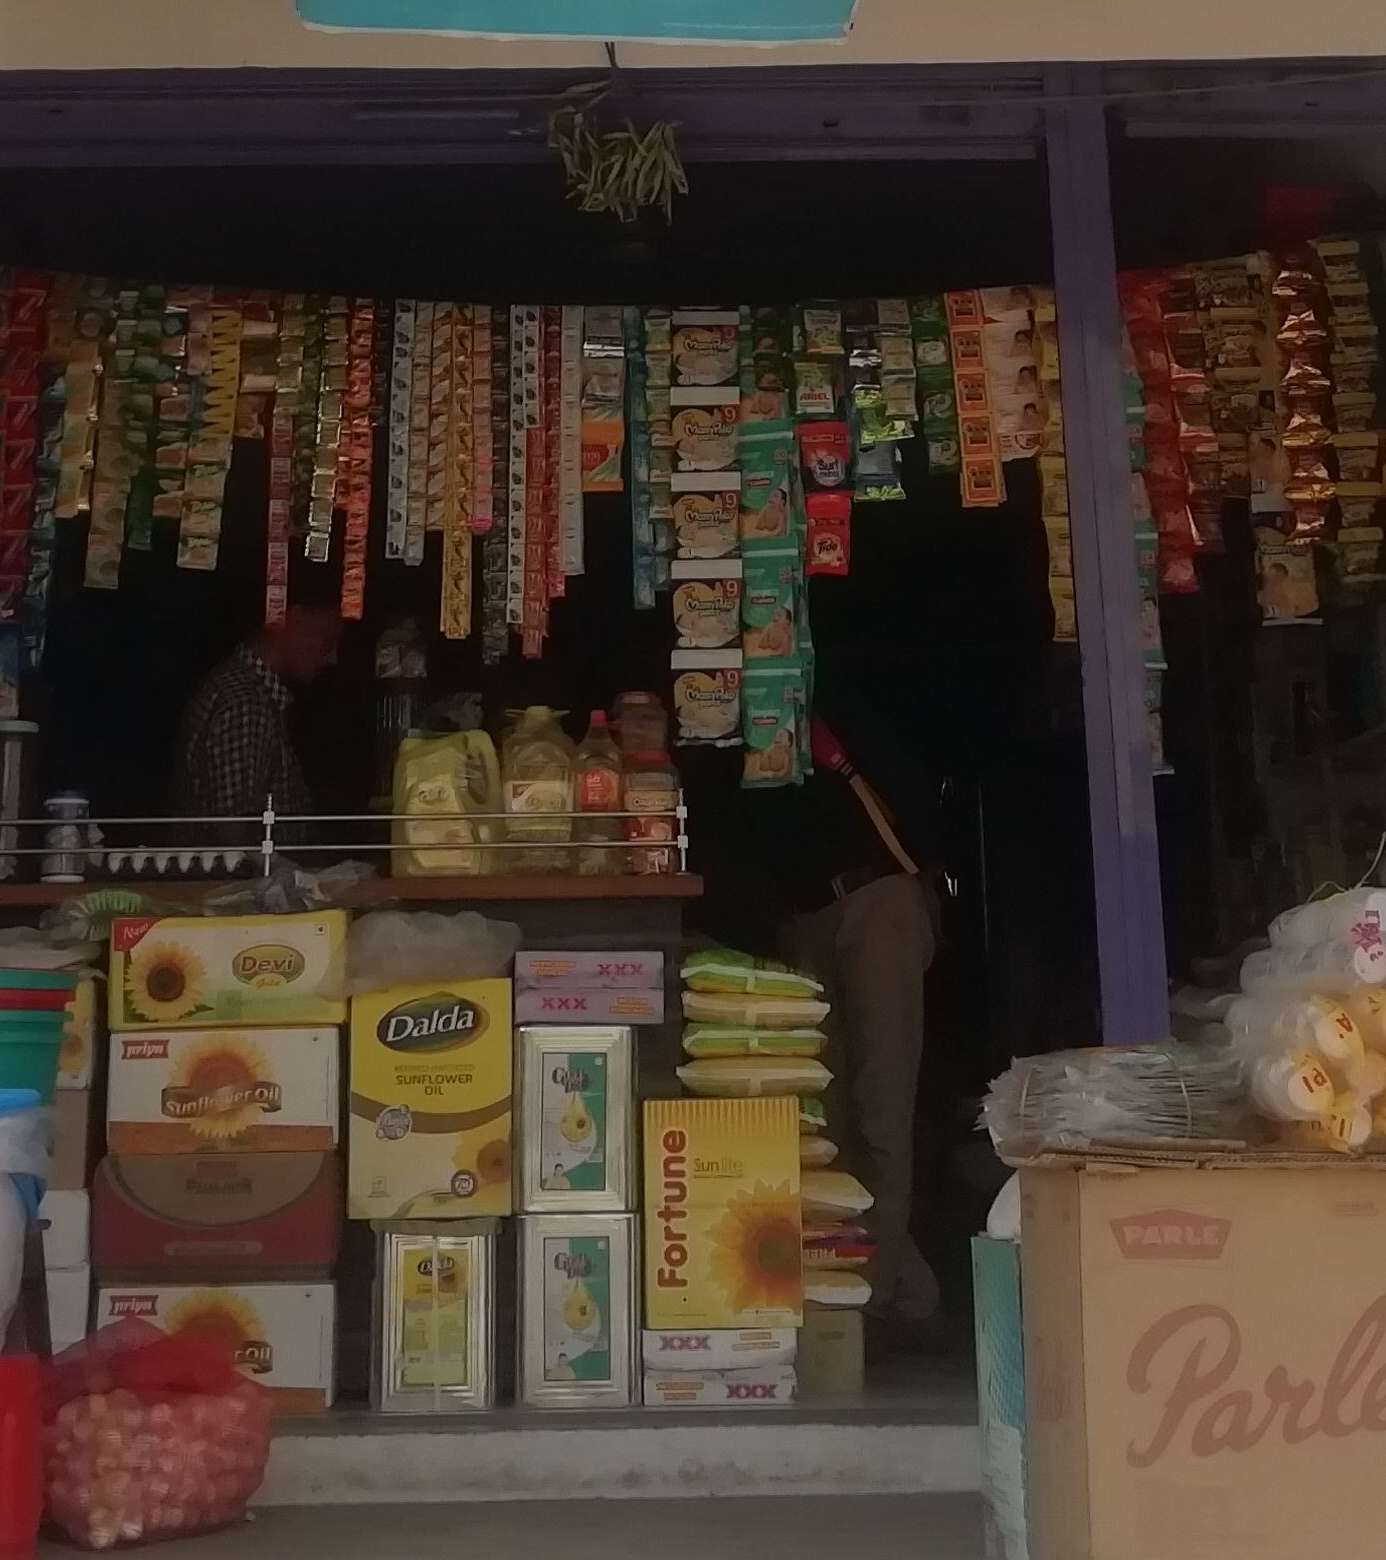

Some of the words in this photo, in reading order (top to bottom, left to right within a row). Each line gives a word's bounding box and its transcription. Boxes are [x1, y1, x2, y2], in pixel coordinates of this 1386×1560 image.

[725, 493, 736, 508] 9
[726, 580, 738, 597] 9
[727, 670, 739, 687] 9
[240, 954, 295, 973] Devi
[598, 962, 646, 978] XXX
[540, 996, 589, 1011] XXX
[386, 1005, 475, 1042] Dalda
[395, 1071, 475, 1087] SUNFLOWER
[253, 1085, 281, 1105] Oil
[423, 1084, 445, 1097] OIL
[657, 1127, 689, 1289] Fortune
[659, 1335, 712, 1351] XXX
[726, 1383, 778, 1399] XXX
